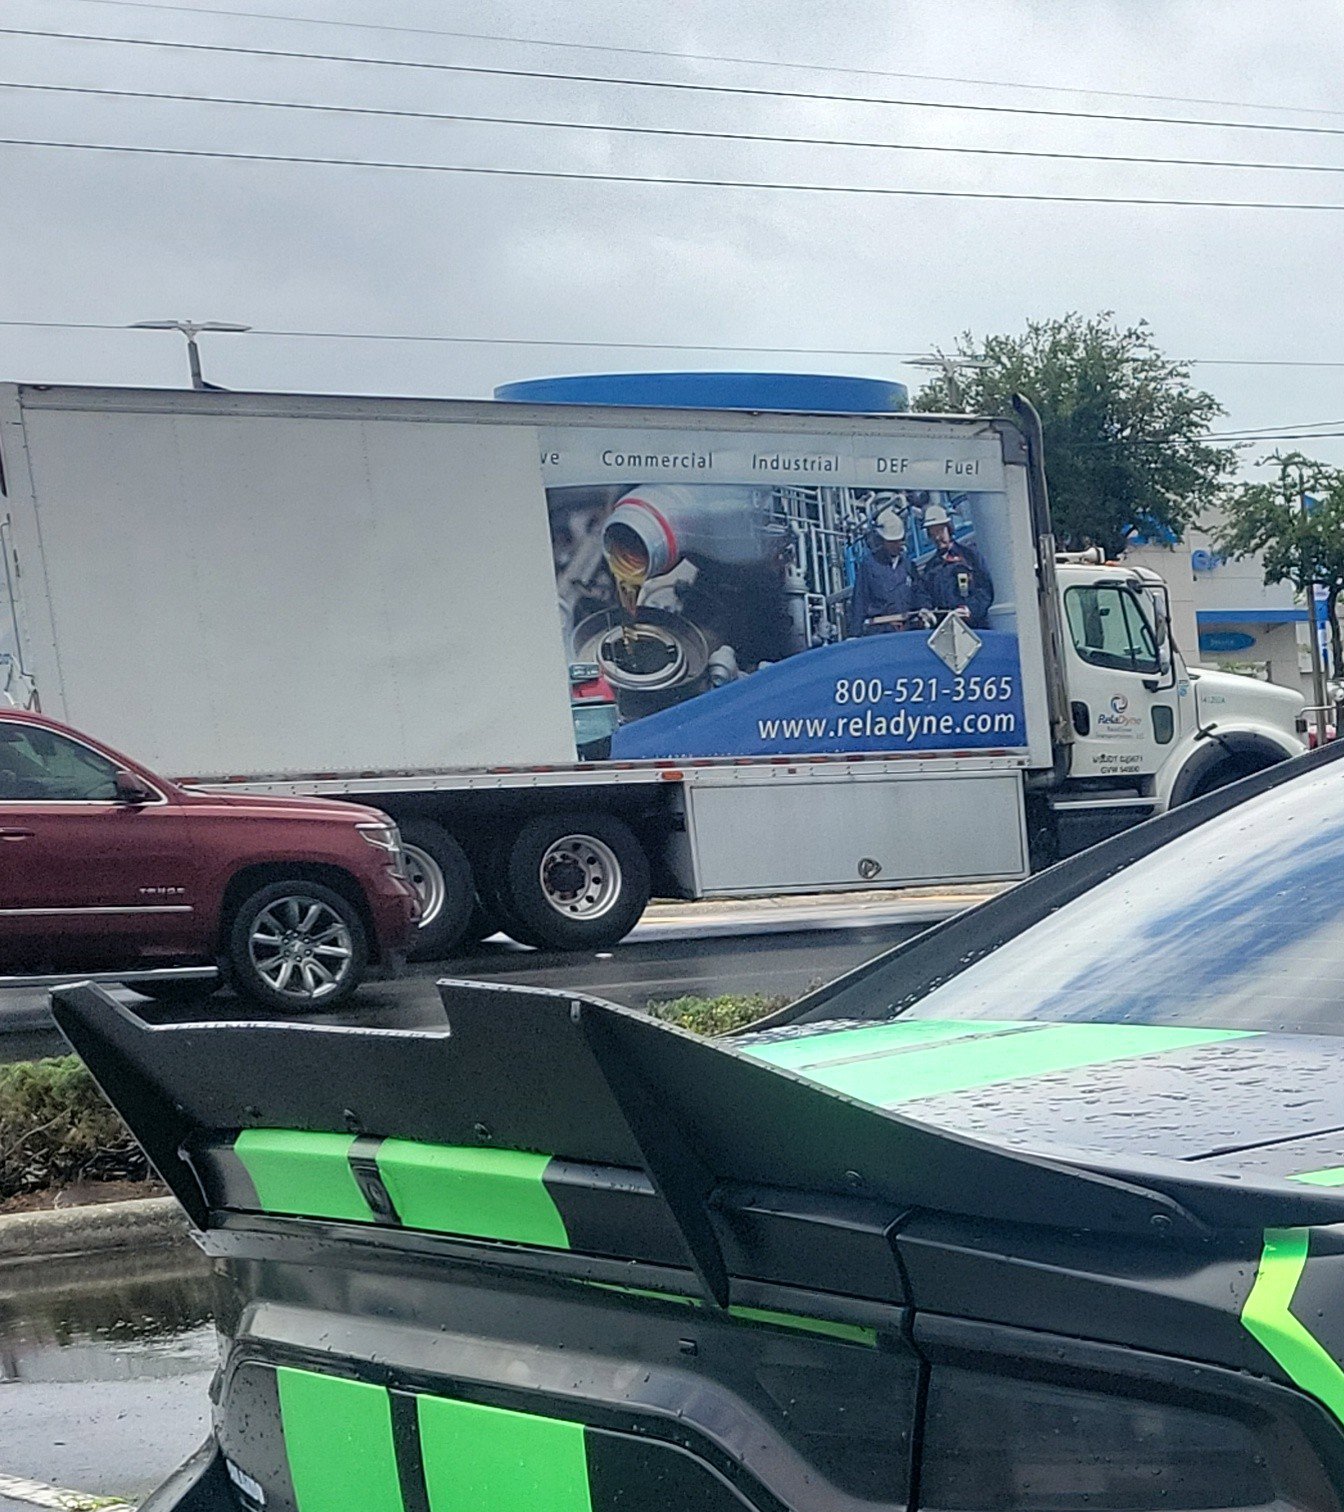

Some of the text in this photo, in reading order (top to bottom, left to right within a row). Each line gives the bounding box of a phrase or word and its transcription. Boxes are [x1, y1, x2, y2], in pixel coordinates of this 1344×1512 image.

[602, 450, 713, 469] Commercial
[752, 454, 839, 472] Industrial
[876, 457, 909, 473] DEF
[945, 459, 979, 475] Fuel
[834, 676, 1013, 704] 800-521-3565
[758, 709, 1016, 742] www.reladyne.com
